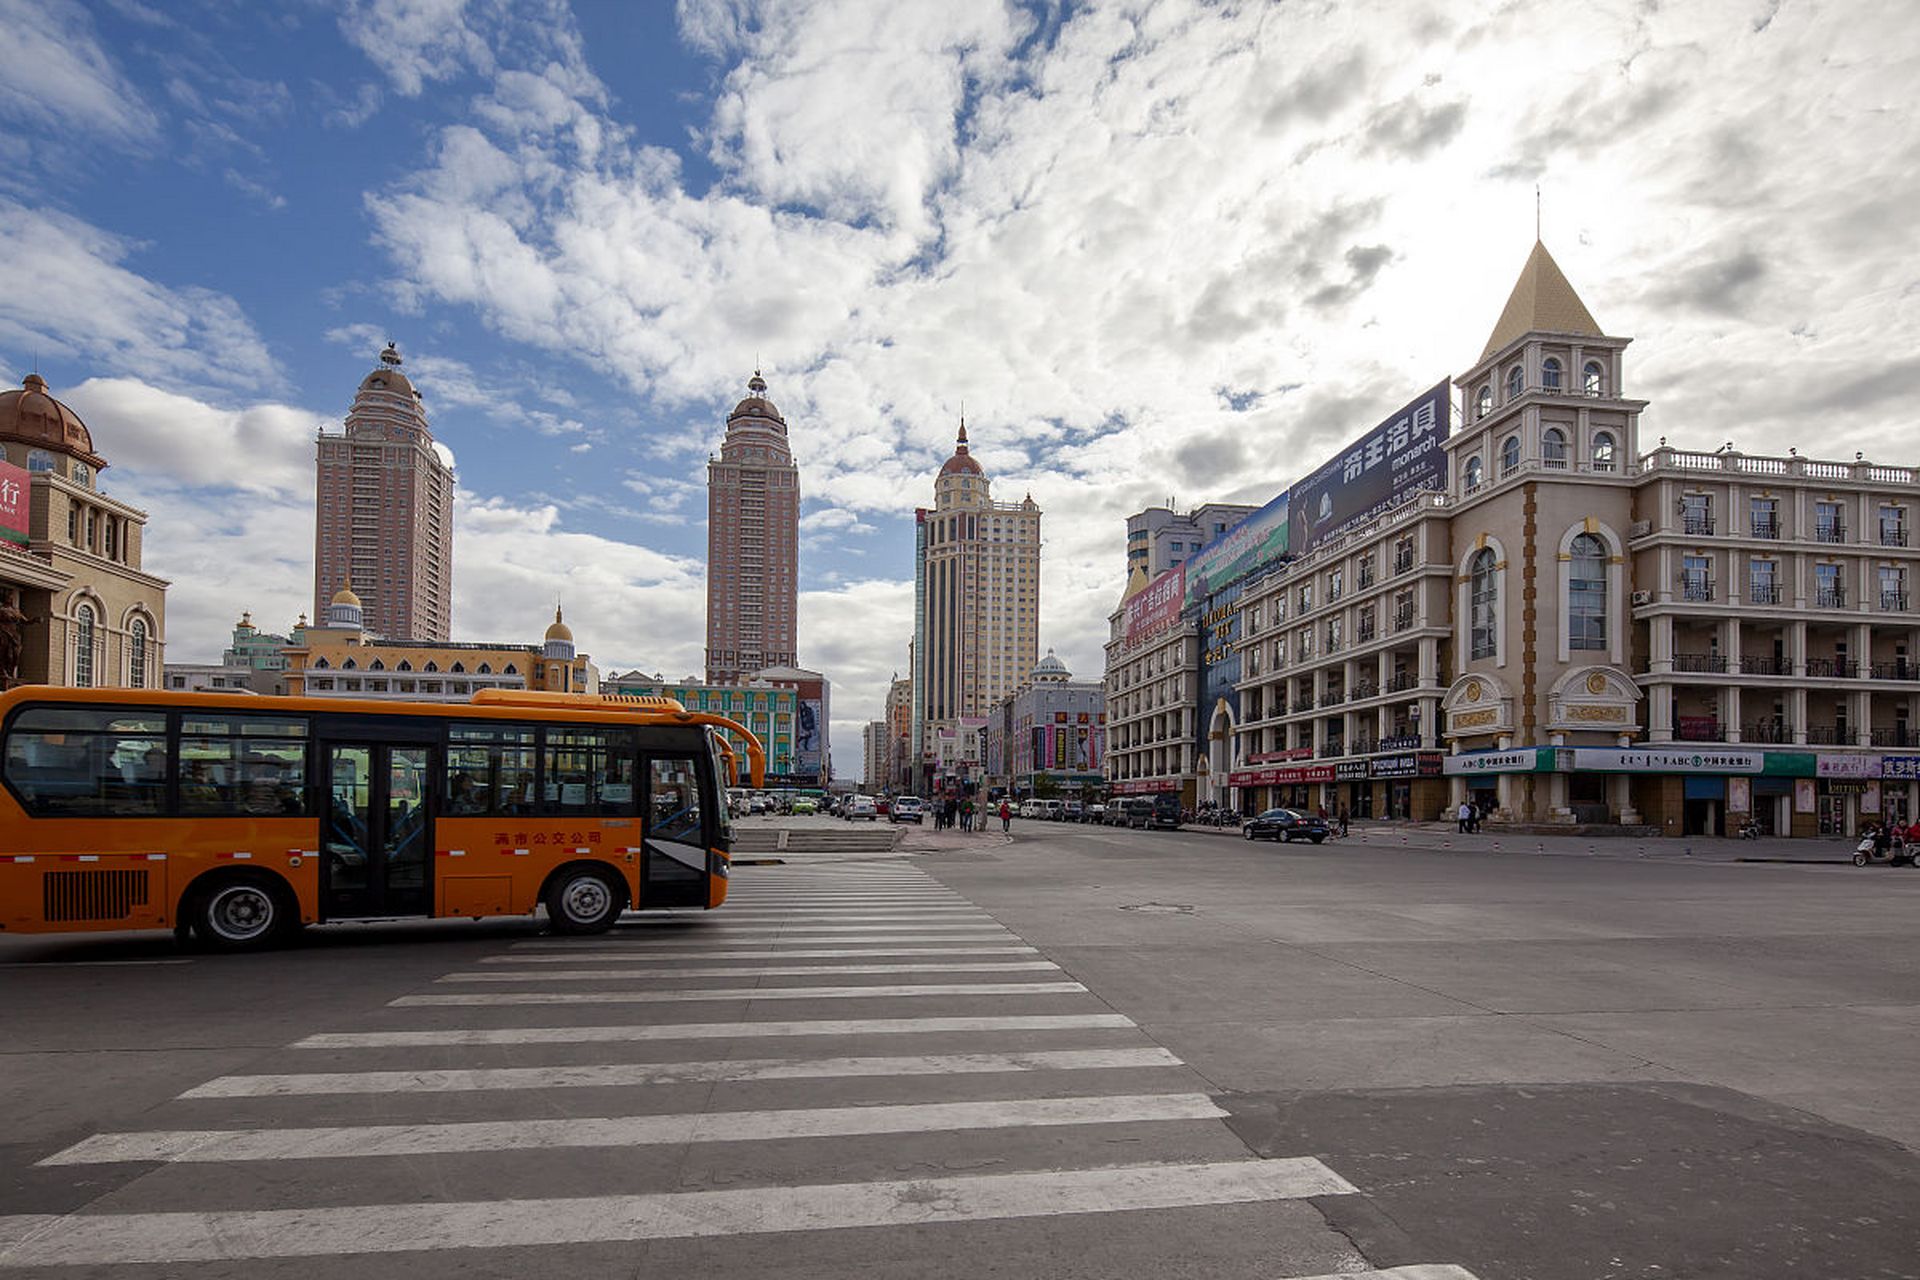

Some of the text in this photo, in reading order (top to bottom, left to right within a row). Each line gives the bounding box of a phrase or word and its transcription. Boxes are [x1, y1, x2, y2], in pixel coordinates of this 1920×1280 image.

[1391, 434, 1436, 472] monarch
[1, 479, 20, 505] 行
[1669, 757, 1690, 766] ABC
[1703, 756, 1751, 766] 中国农业银行
